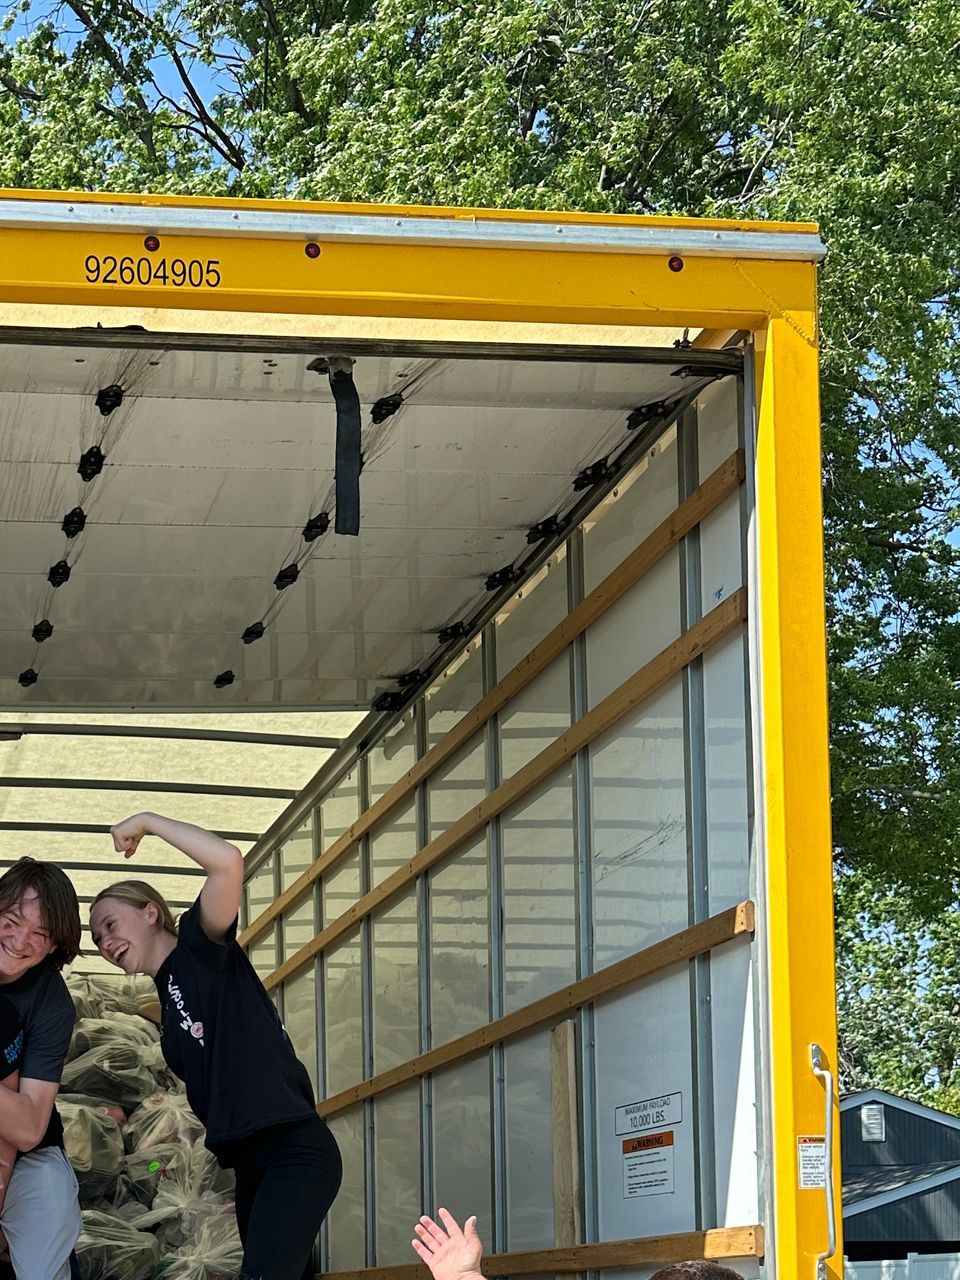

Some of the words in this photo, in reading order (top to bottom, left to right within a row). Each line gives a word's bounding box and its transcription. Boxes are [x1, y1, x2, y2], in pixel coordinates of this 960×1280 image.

[85, 255, 221, 287] 92604905
[625, 1102, 649, 1115] MAXIMUM
[649, 1098, 671, 1110] PAYLOAD
[630, 1113, 651, 1128] 10,000
